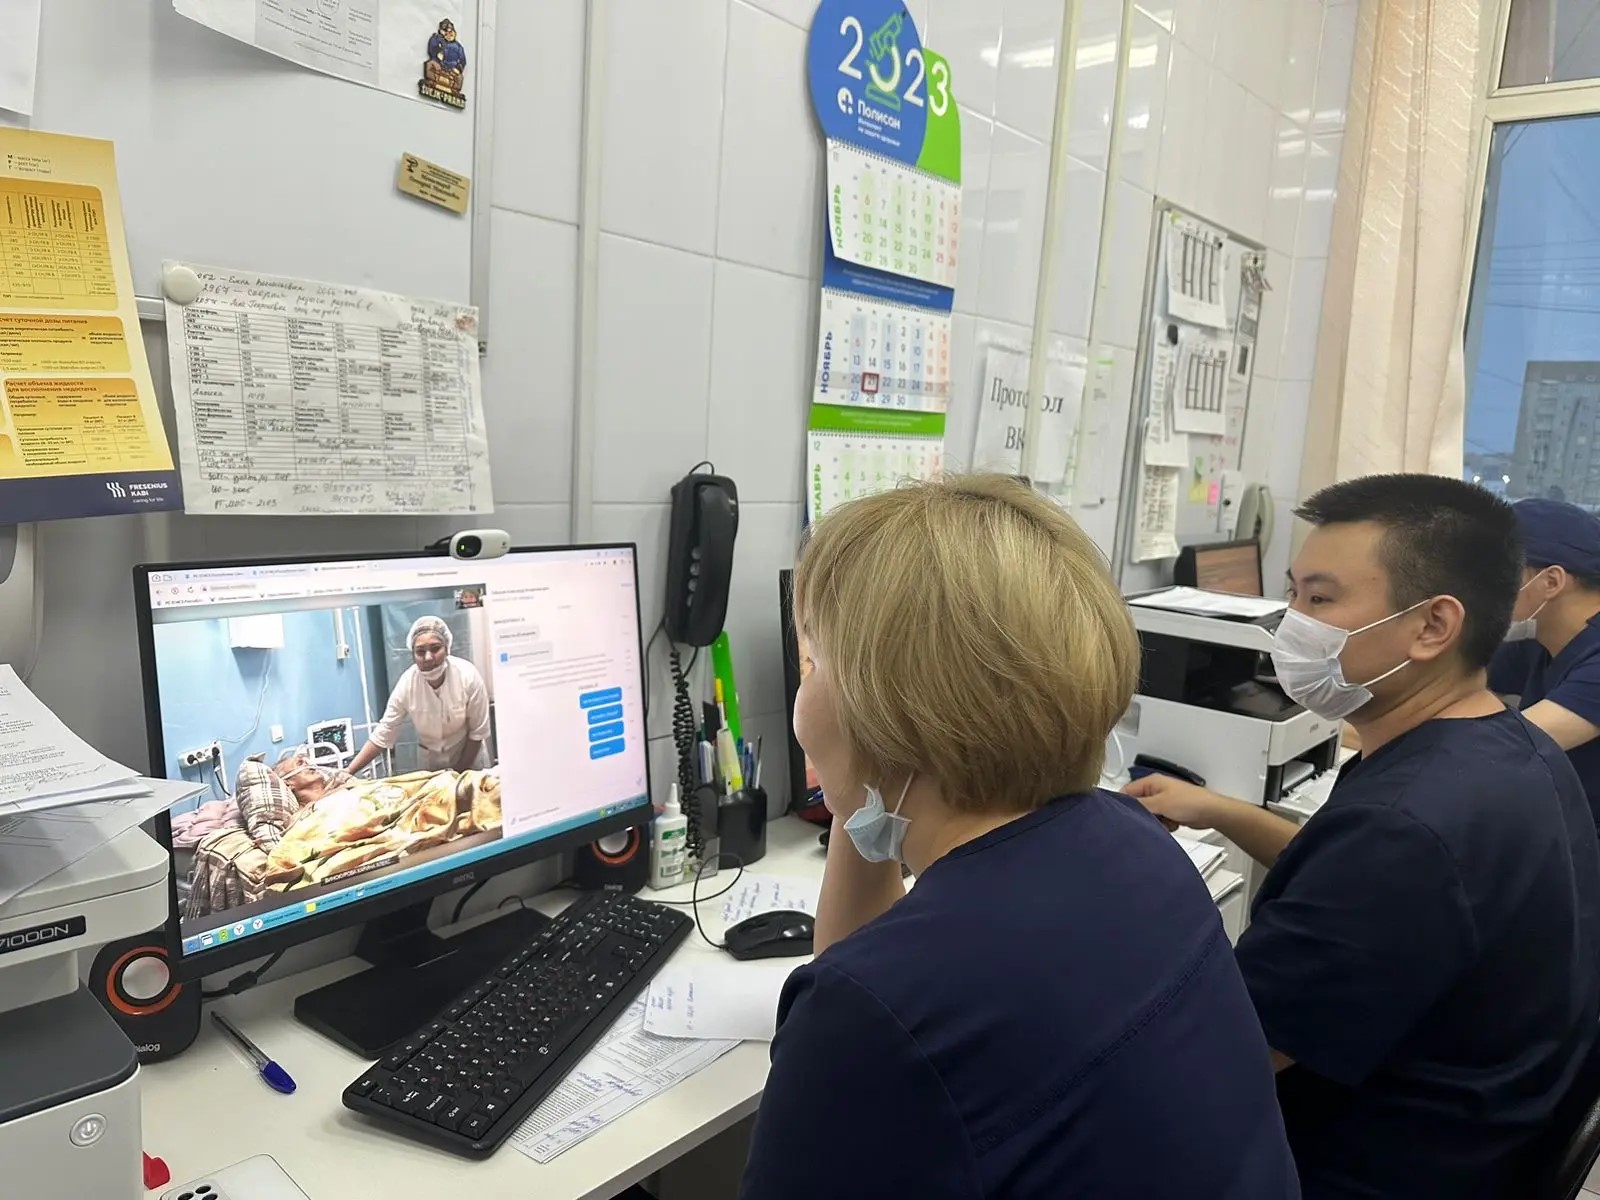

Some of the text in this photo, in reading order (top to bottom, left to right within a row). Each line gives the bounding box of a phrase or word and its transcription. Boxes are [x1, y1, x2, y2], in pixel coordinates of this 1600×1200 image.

[857, 99, 901, 130] Полисан
[820, 331, 833, 394] НОЯБРЬ
[991, 376, 1064, 414] Протоол
[129, 481, 168, 490] FRESENIUS
[131, 489, 149, 497] KABI
